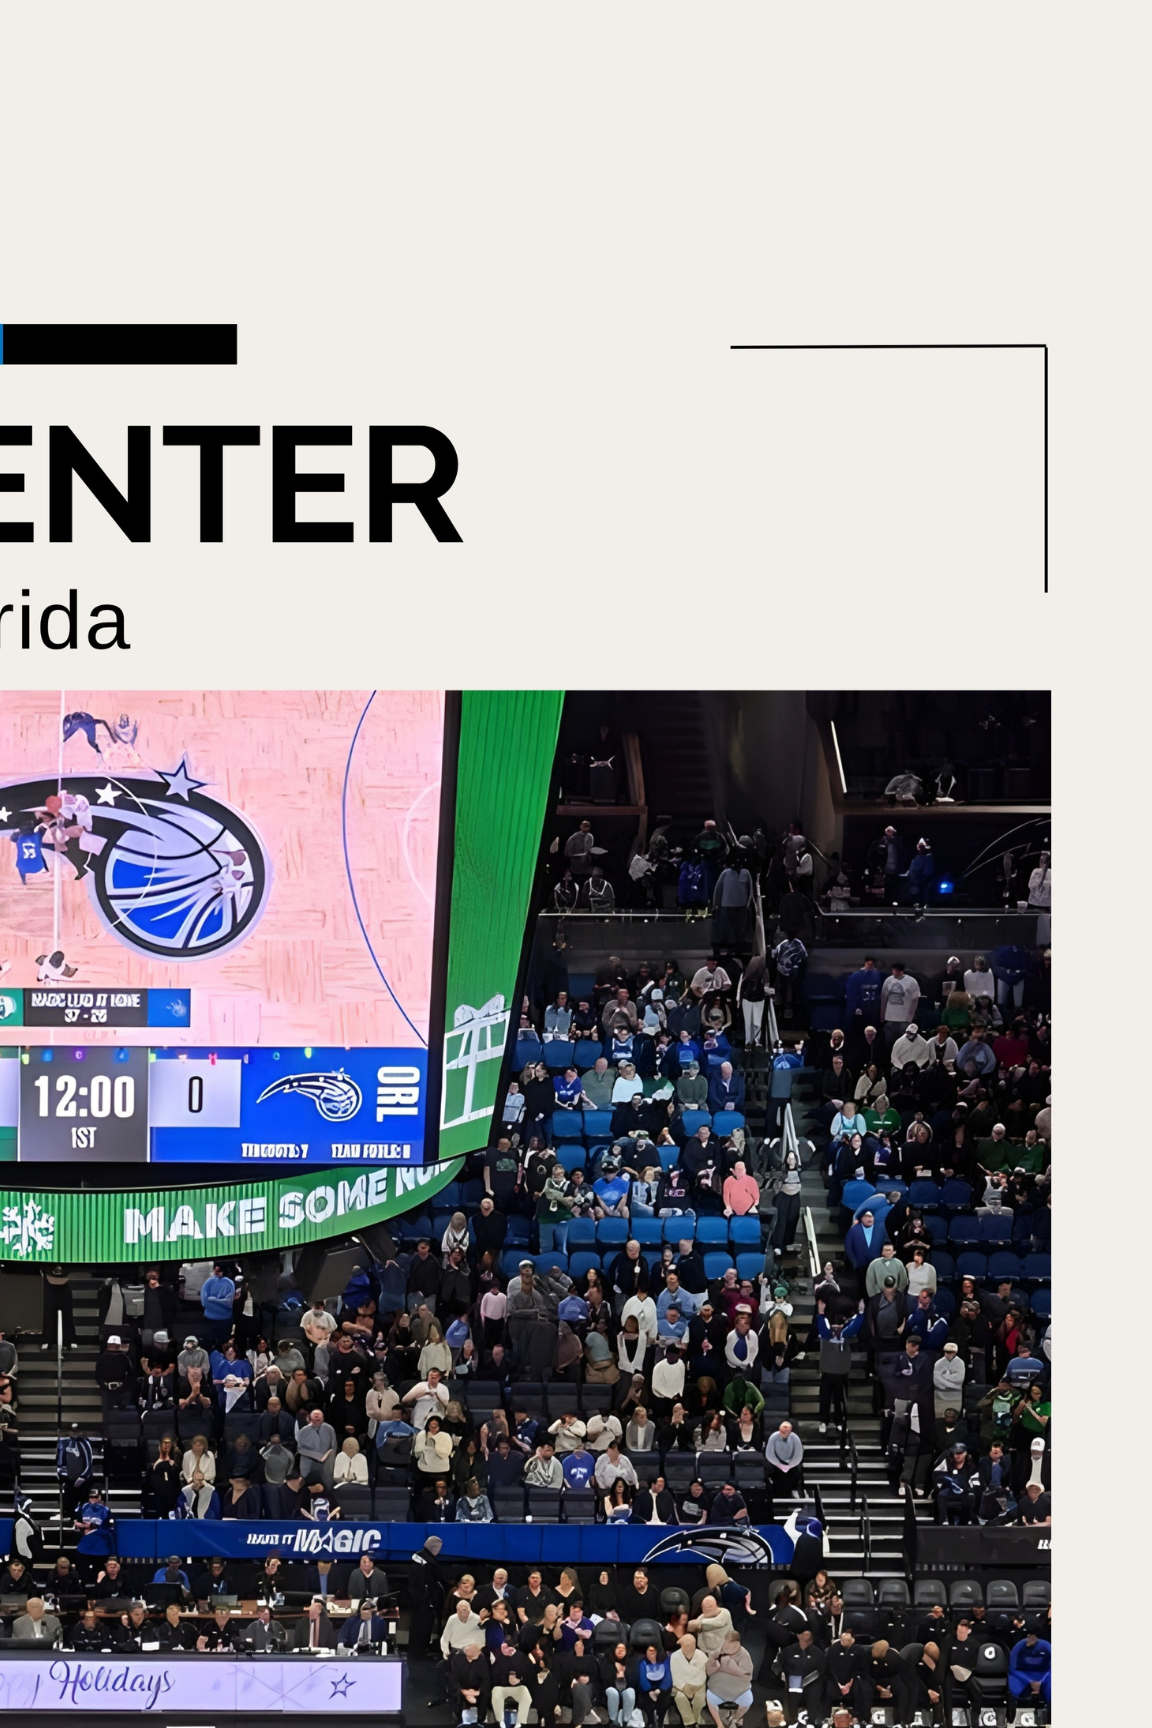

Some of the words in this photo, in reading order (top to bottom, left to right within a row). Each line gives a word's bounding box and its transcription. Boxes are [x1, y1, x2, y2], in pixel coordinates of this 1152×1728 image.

[34, 1075, 134, 1118] 12:00
[188, 1076, 203, 1113] 0
[376, 1066, 420, 1122] ORL
[124, 1197, 266, 1243] MAKE
[279, 1168, 387, 1228] SOME
[50, 1660, 176, 1709] Holidays
